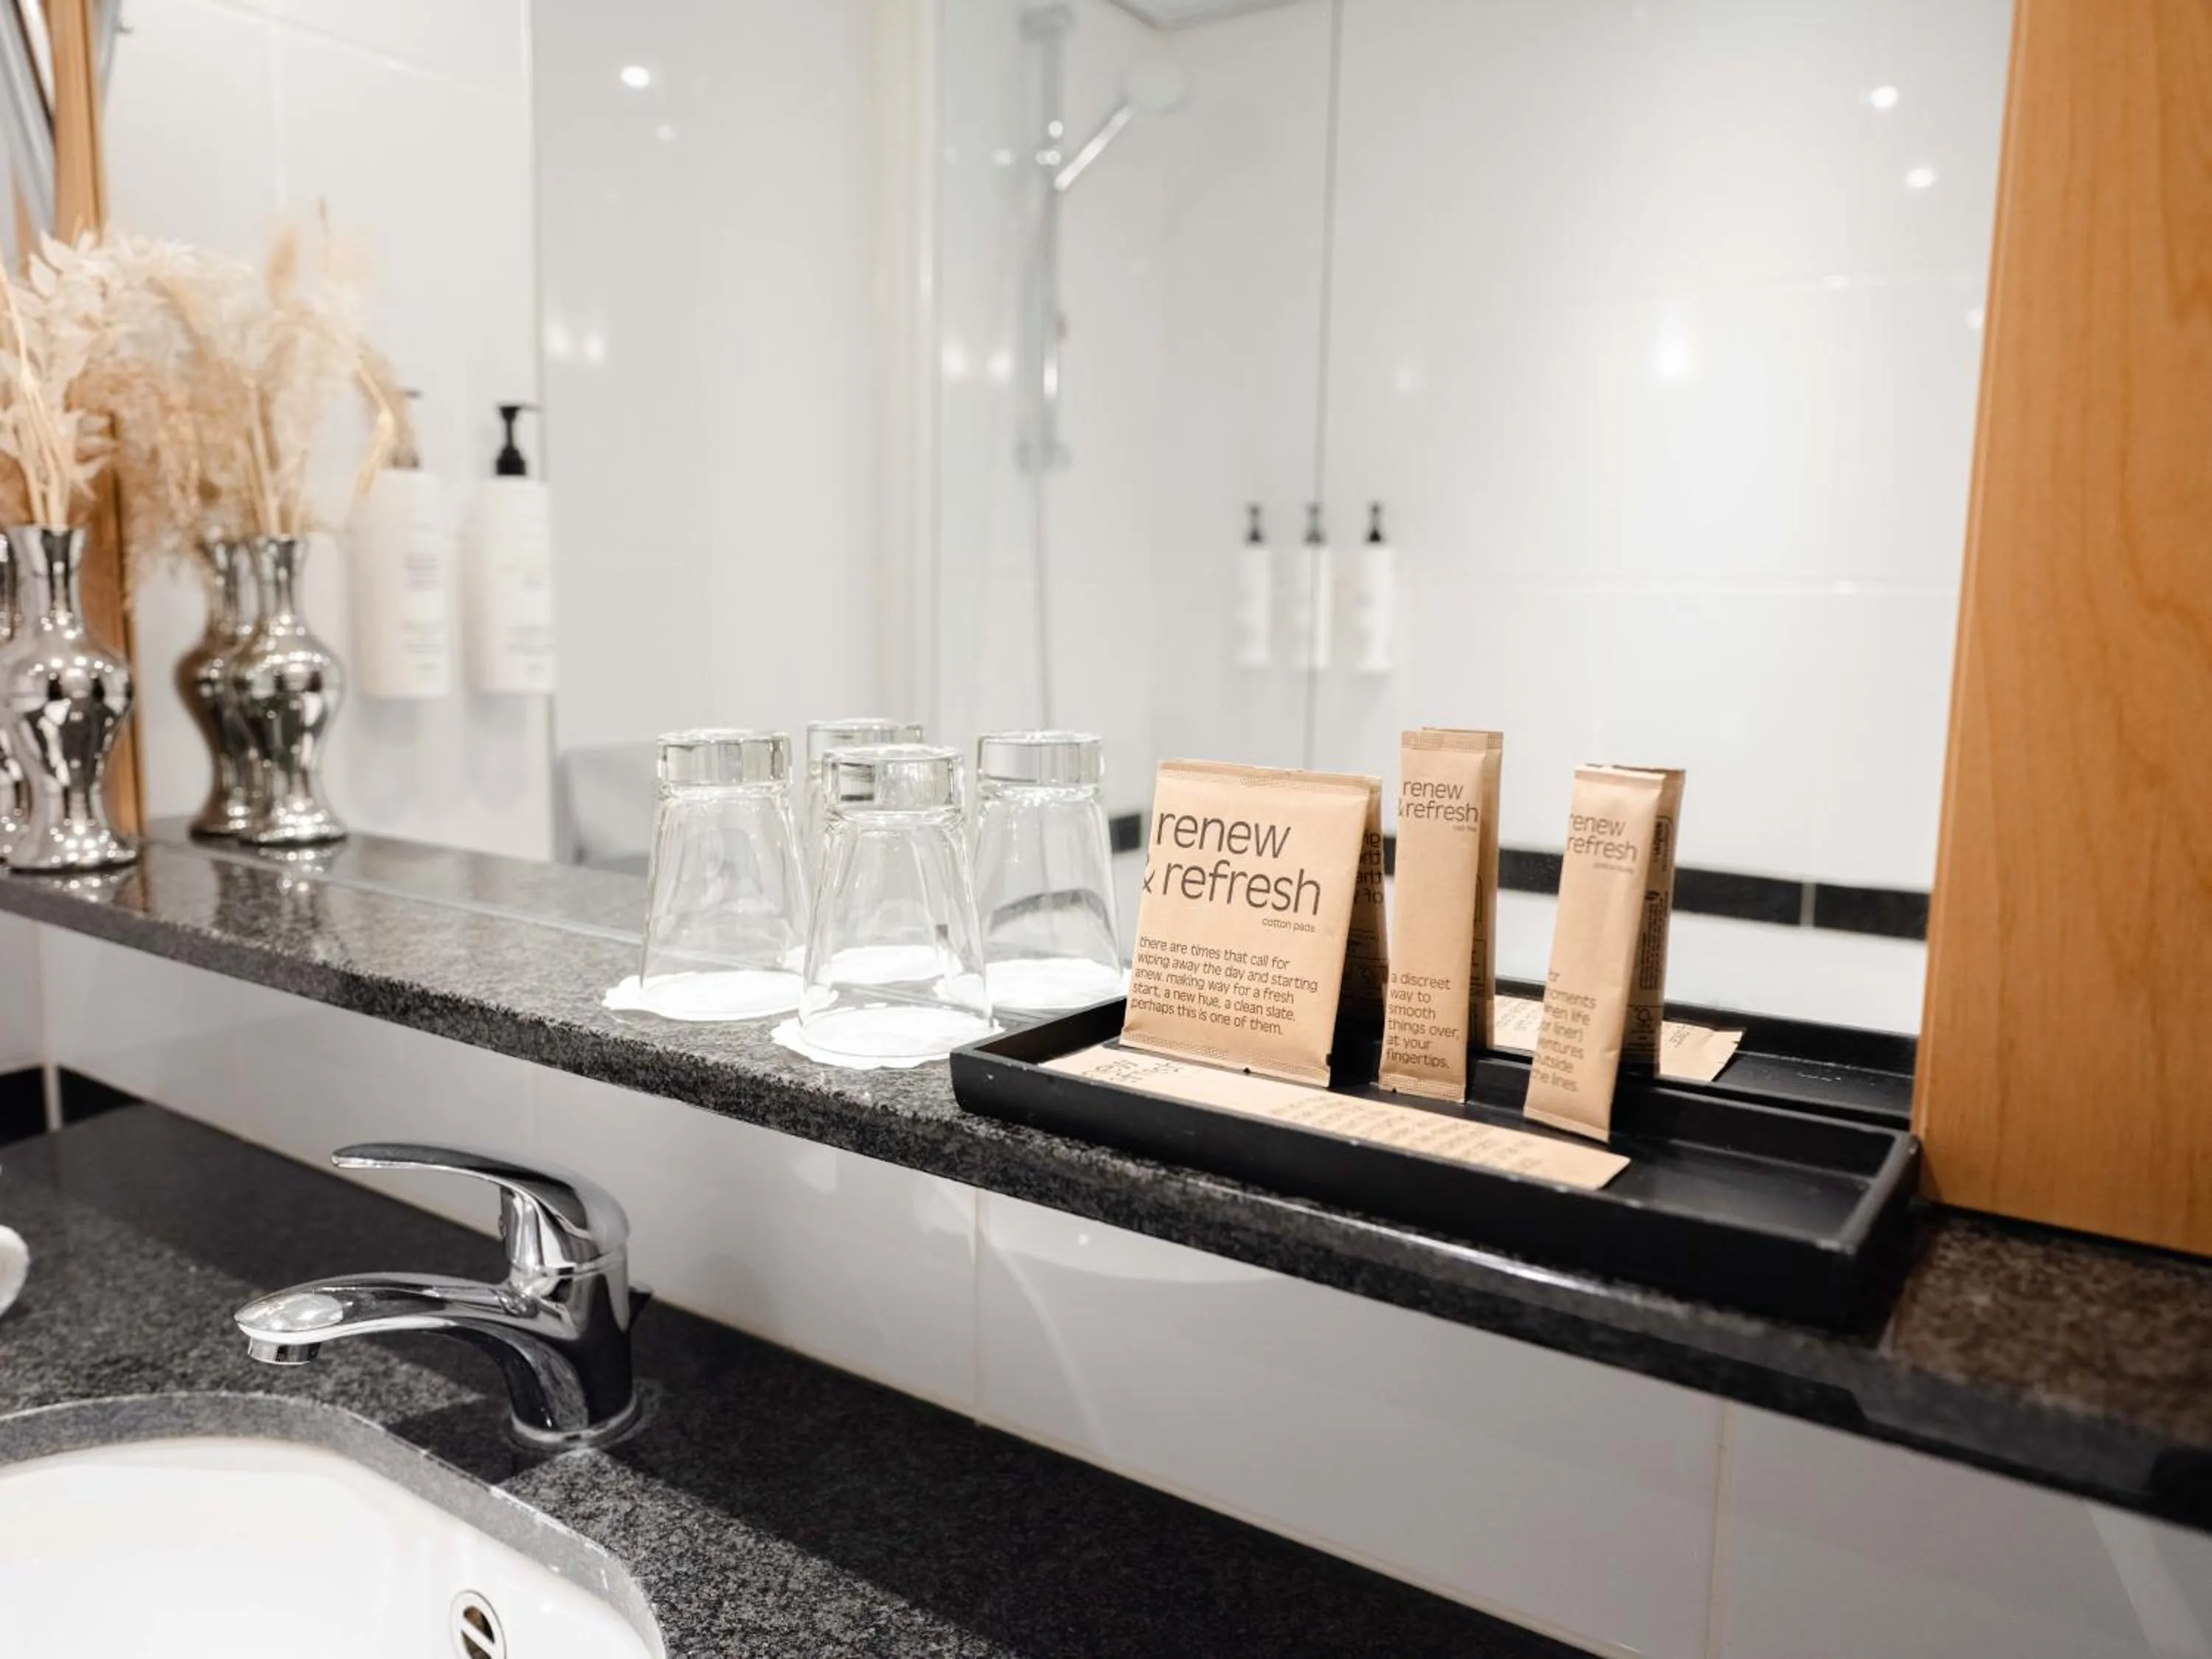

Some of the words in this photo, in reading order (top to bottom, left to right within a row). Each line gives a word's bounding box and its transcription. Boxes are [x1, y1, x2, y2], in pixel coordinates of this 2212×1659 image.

[1403, 780, 1464, 800] renew
[1405, 800, 1479, 823] refresh
[1156, 812, 1292, 859] renew
[1162, 859, 1321, 915] refresh
[1262, 918, 1291, 930] cotton
[1293, 922, 1316, 933] pads
[1139, 936, 1167, 951] there
[1169, 942, 1187, 954] are
[1191, 944, 1220, 960] times
[1224, 949, 1248, 964] that
[1250, 955, 1269, 967] call
[1271, 956, 1290, 970] for
[1138, 953, 1170, 969] wiping
[1172, 959, 1200, 973] away
[1203, 961, 1222, 975] the
[1225, 964, 1245, 981] day
[1247, 970, 1269, 983] and
[1270, 975, 1318, 993] starting
[1400, 973, 1451, 990] discreet
[1166, 973, 1205, 990] making
[1208, 980, 1231, 994] way
[1233, 982, 1251, 995] for
[1253, 988, 1260, 998] a
[1263, 987, 1294, 1004] fresh
[1389, 989, 1413, 1004] way
[1417, 990, 1432, 1004] to
[1130, 998, 1175, 1015] perhaps
[1178, 1003, 1197, 1019] this
[1198, 1007, 1207, 1022] is
[1209, 1012, 1231, 1026] one
[1234, 1016, 1247, 1028] of
[1164, 989, 1171, 999] a
[1173, 990, 1196, 1004] new
[1198, 992, 1221, 1009] hue,
[1225, 999, 1231, 1009] a
[1234, 1000, 1263, 1015] clean
[1266, 1005, 1295, 1021] slate.
[1388, 1004, 1436, 1021] smooth
[1387, 1019, 1427, 1036] things
[1428, 1025, 1459, 1041] over,
[1387, 1034, 1400, 1046] at
[1403, 1037, 1433, 1050] your
[1386, 1047, 1451, 1069] fingertips.
